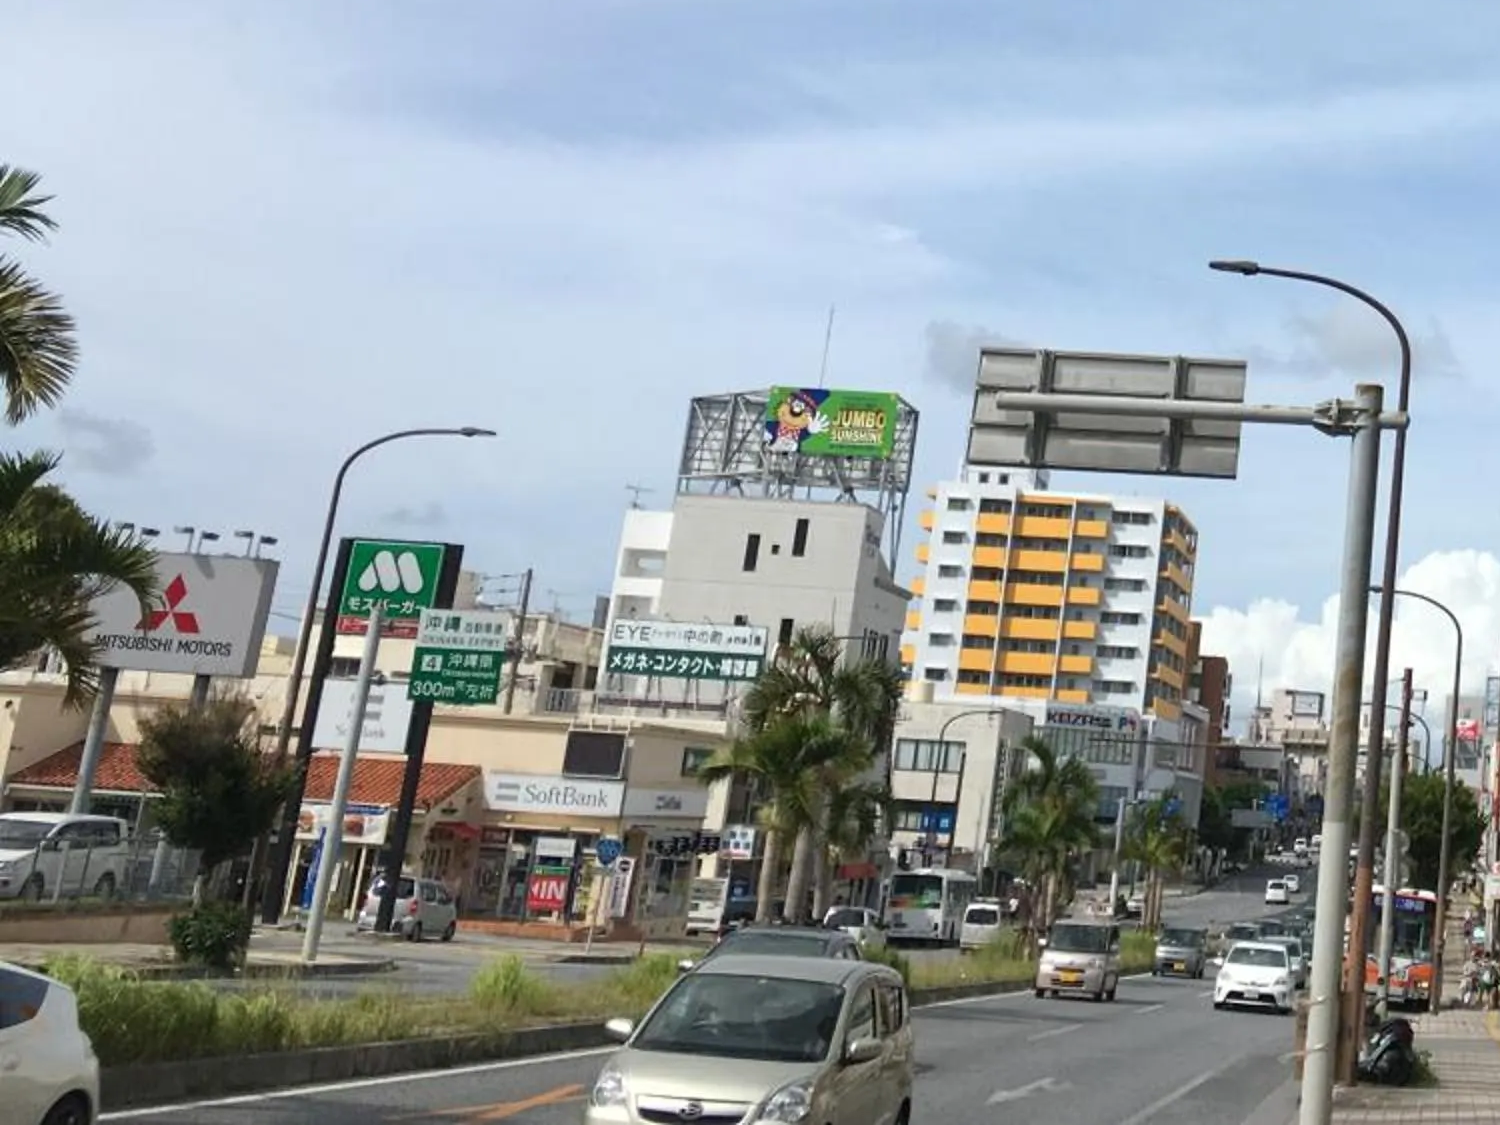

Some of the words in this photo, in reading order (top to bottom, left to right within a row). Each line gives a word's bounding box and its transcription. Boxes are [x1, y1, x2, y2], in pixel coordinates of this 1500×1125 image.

[832, 410, 887, 428] JUMBO
[614, 624, 650, 642] EYE
[95, 634, 174, 652] MITSUBISHI
[176, 640, 233, 657] MOTORS
[524, 783, 609, 809] SoftBank
[539, 881, 568, 901] IN
